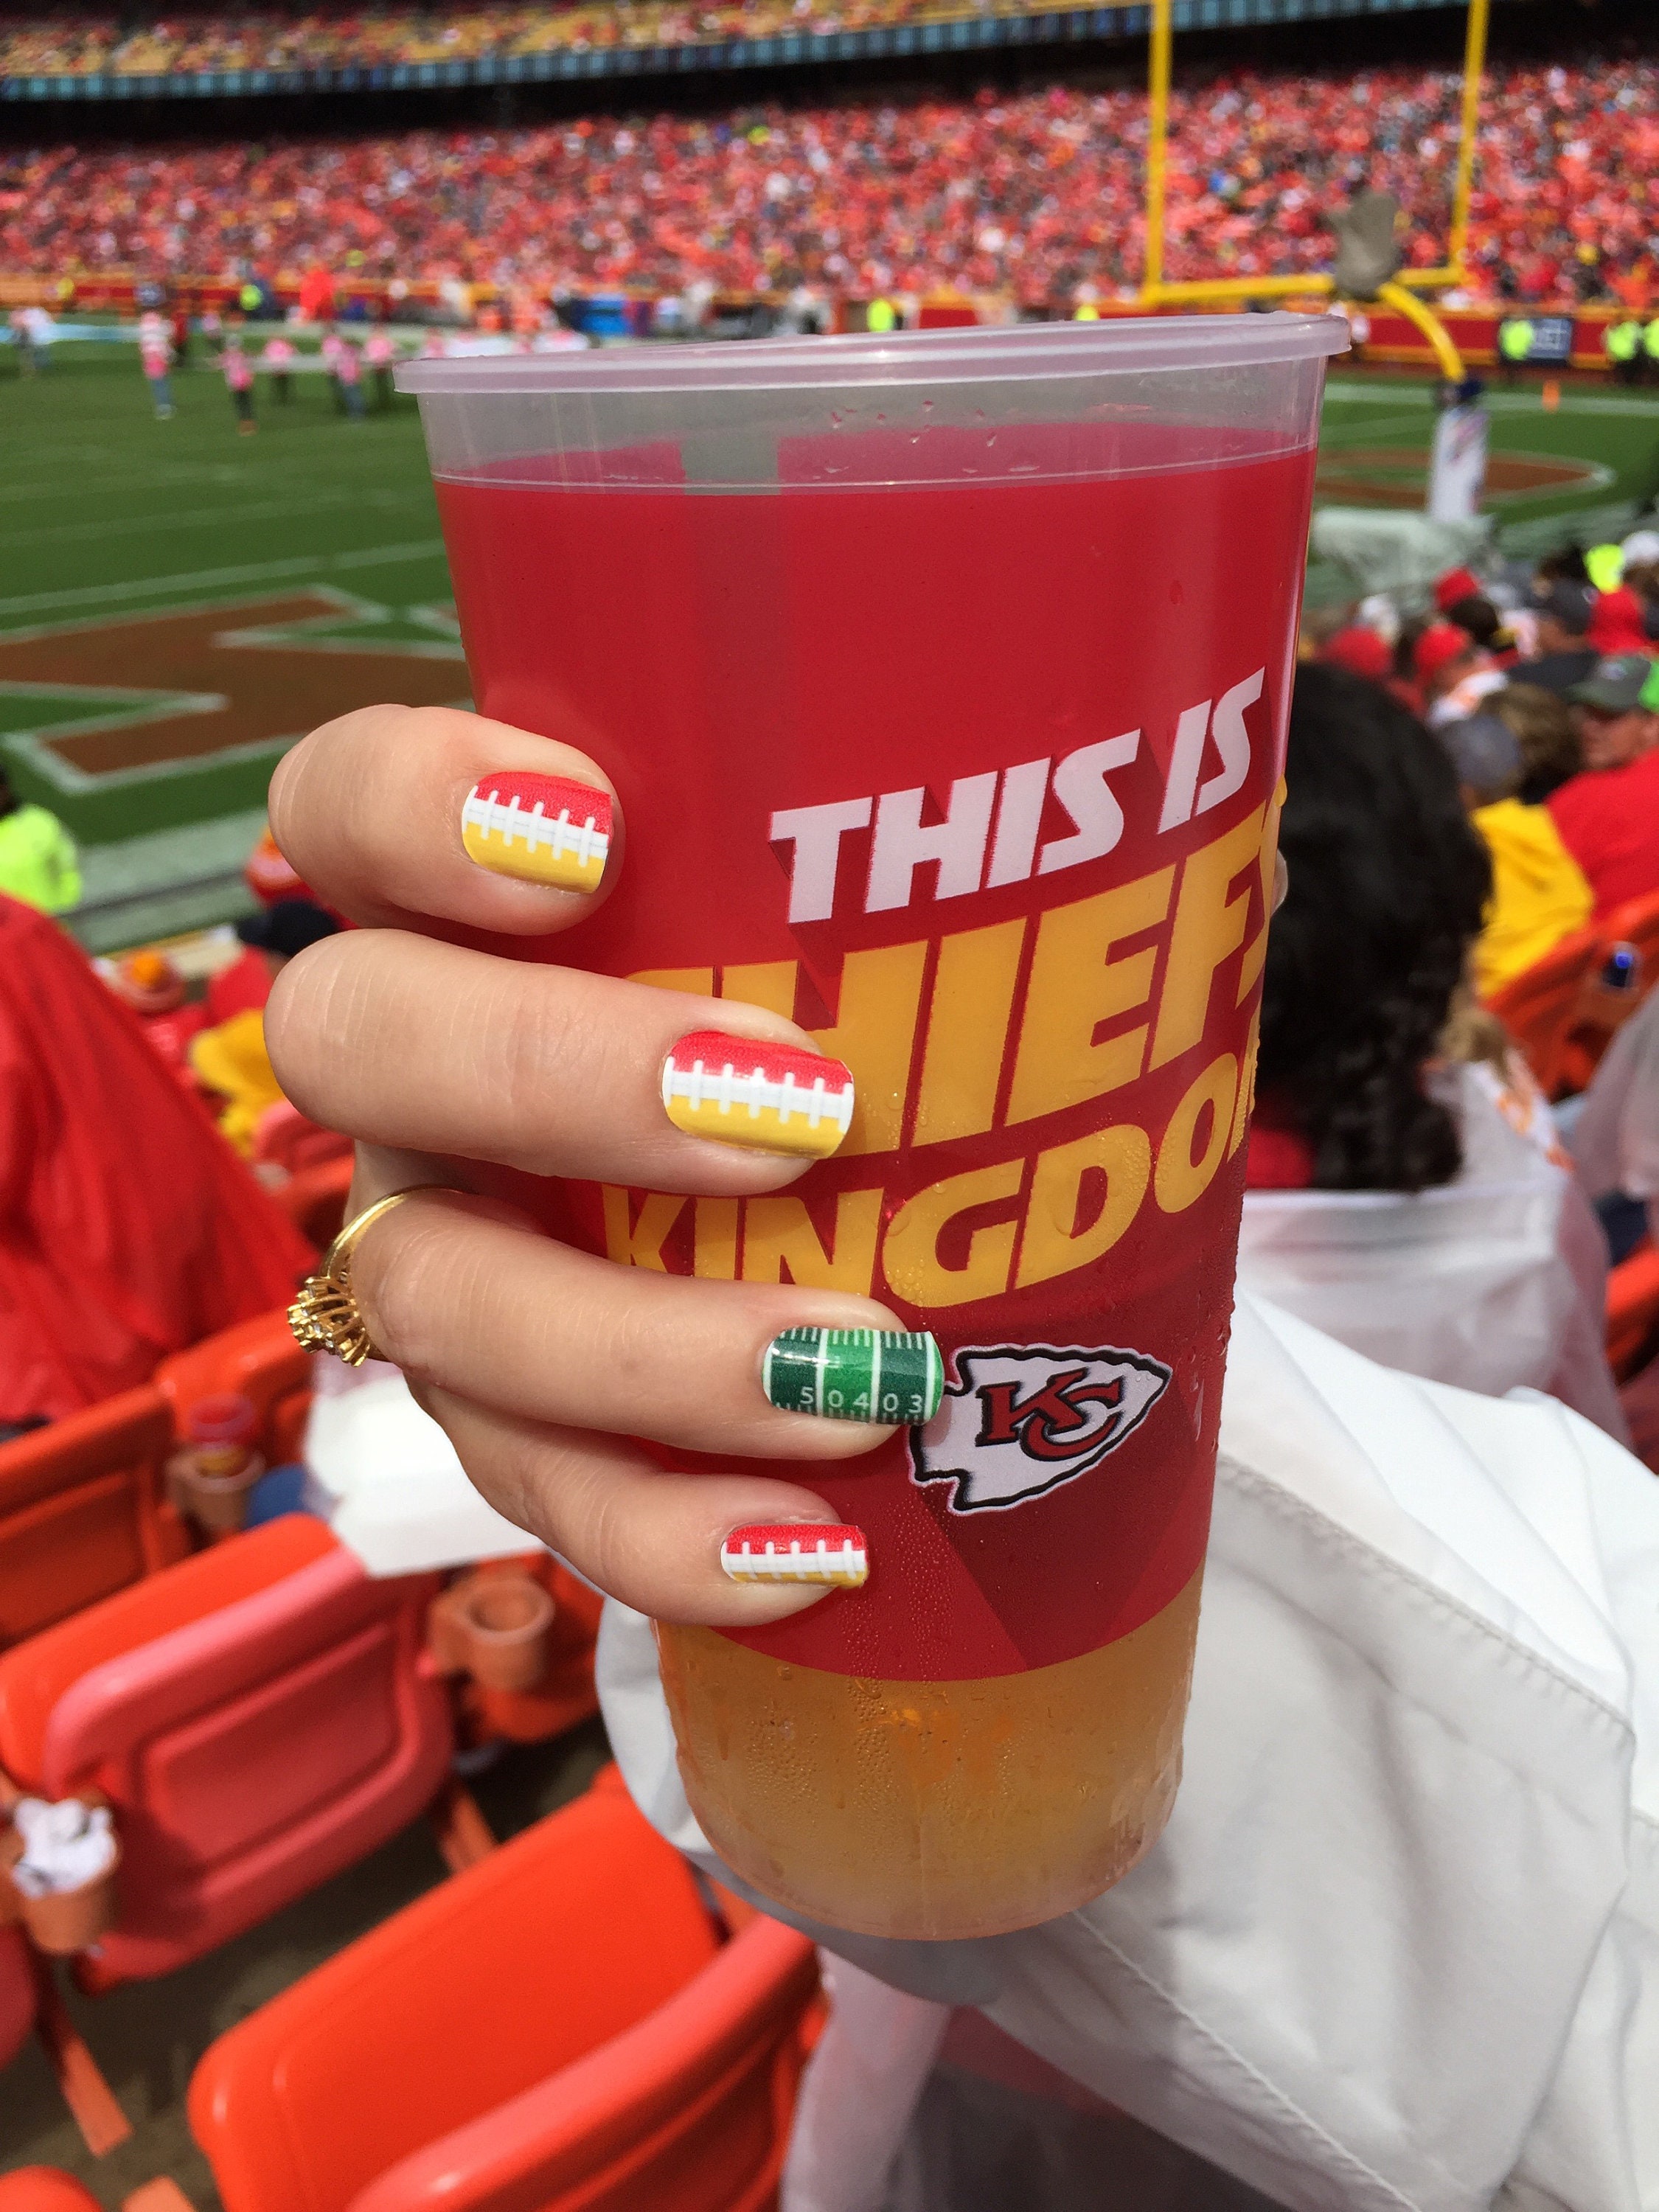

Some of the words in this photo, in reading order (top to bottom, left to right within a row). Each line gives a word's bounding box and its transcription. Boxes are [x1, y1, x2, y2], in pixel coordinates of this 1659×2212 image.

[770, 728, 1141, 924] THIS
[1158, 666, 1265, 834] IS
[624, 782, 1281, 1160] HIEFS
[602, 1007, 1259, 1307] KINGDO
